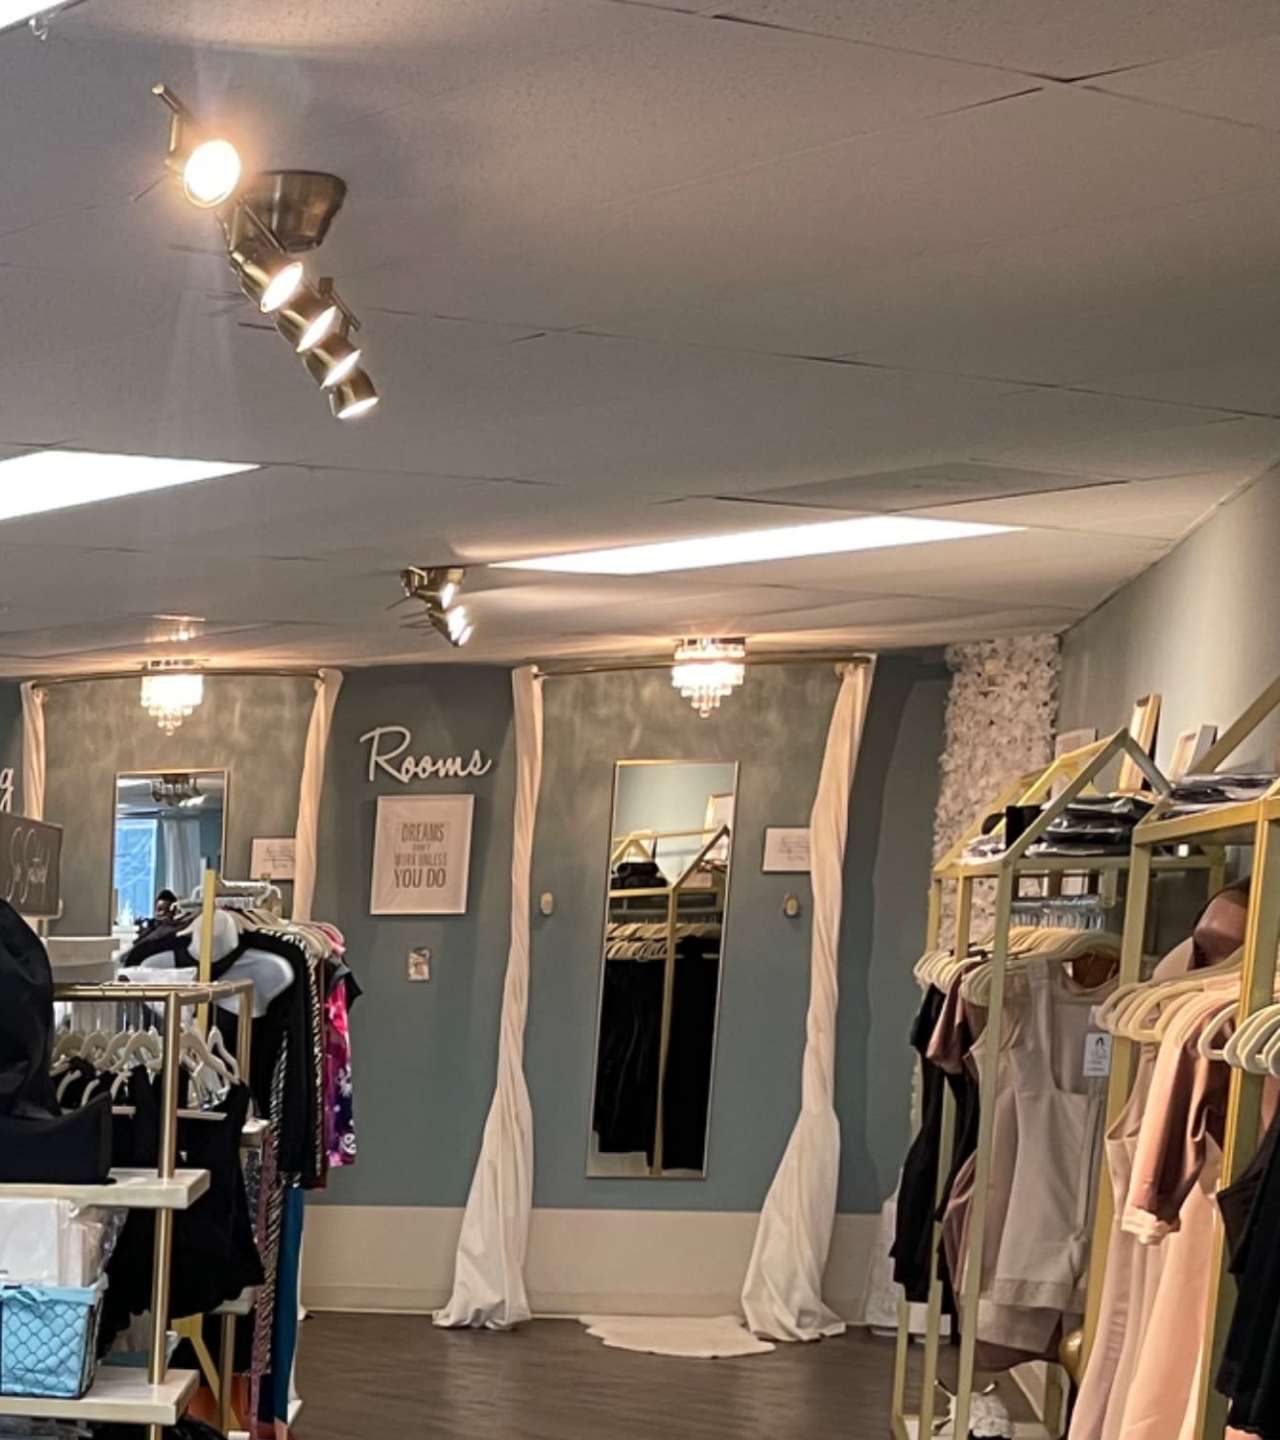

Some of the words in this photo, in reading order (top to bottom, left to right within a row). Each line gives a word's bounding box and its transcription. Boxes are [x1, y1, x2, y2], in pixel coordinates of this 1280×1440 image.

[359, 725, 492, 783] Rooms
[402, 823, 444, 842] DREAMS
[393, 868, 423, 889] YOU
[426, 868, 447, 889] DO
